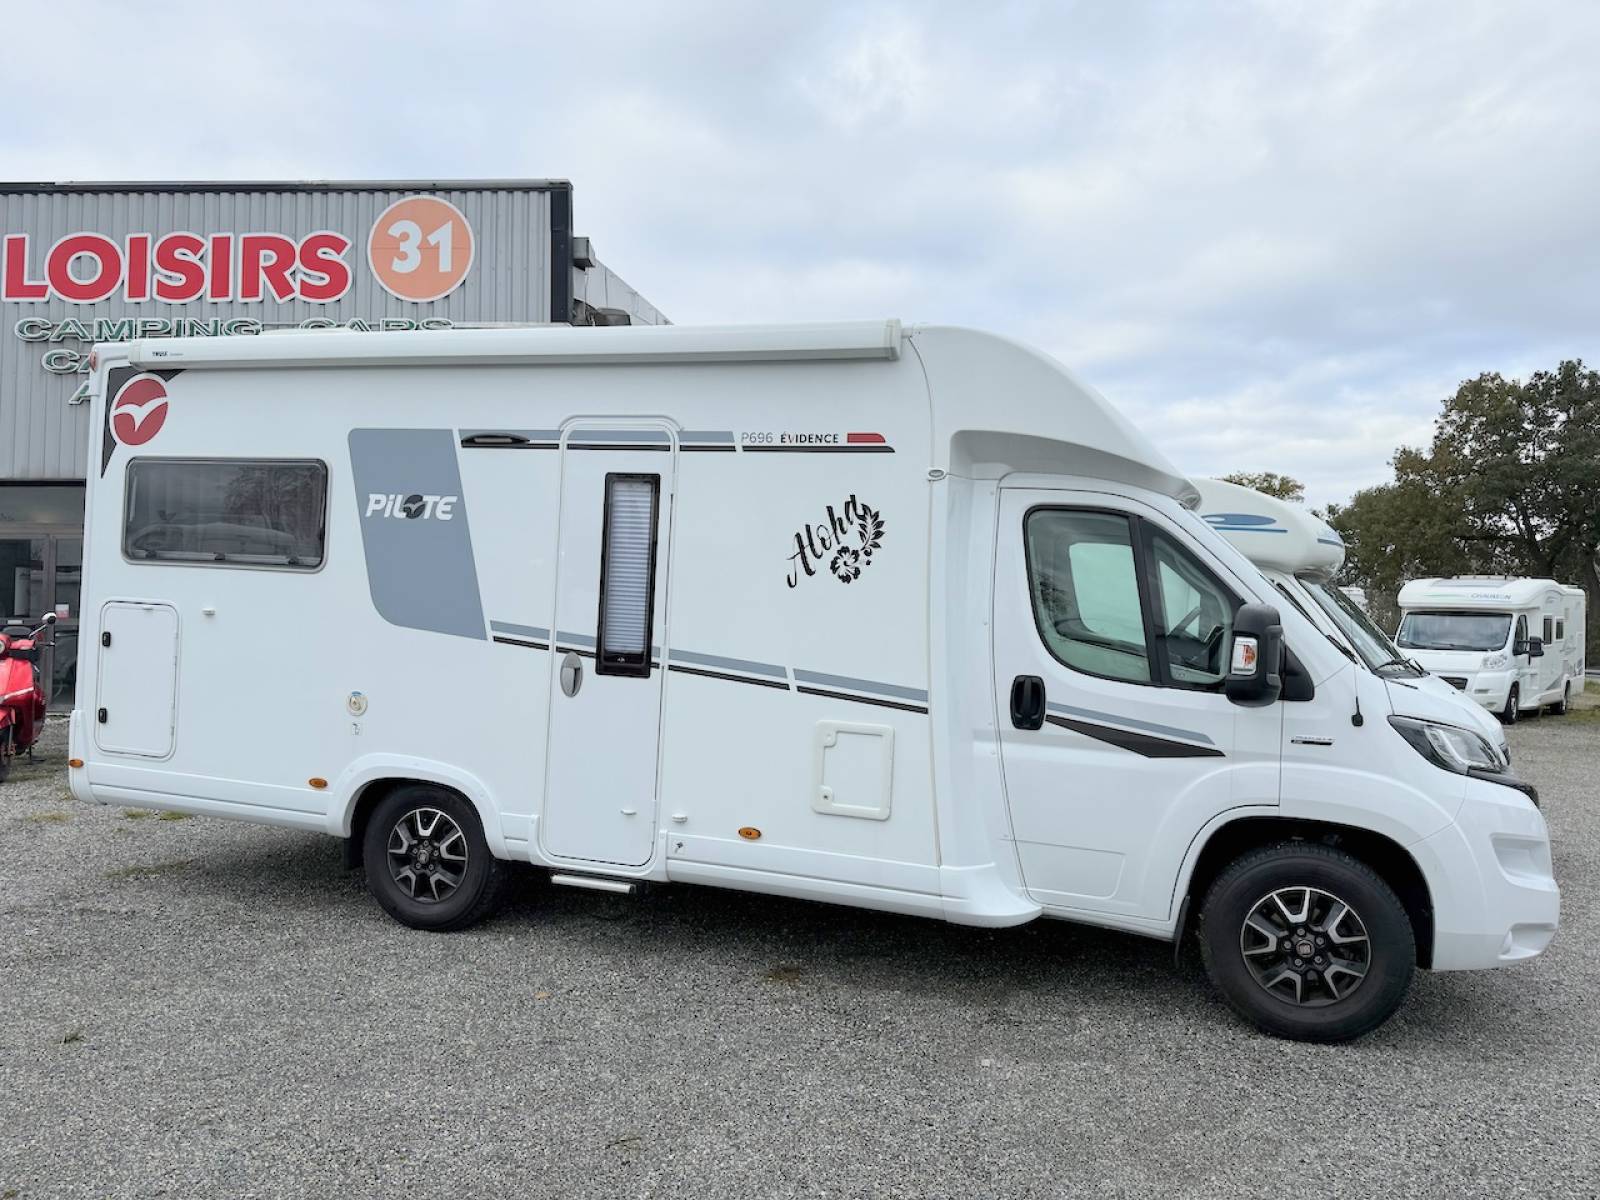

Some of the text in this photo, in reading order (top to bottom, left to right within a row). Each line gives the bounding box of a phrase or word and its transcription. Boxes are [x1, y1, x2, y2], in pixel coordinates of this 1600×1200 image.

[3, 219, 453, 304] LOISIRS 31
[14, 317, 264, 342] CAMPING
[741, 431, 839, 444] P696 ÉVIDENCE
[786, 494, 866, 588] Aloha
